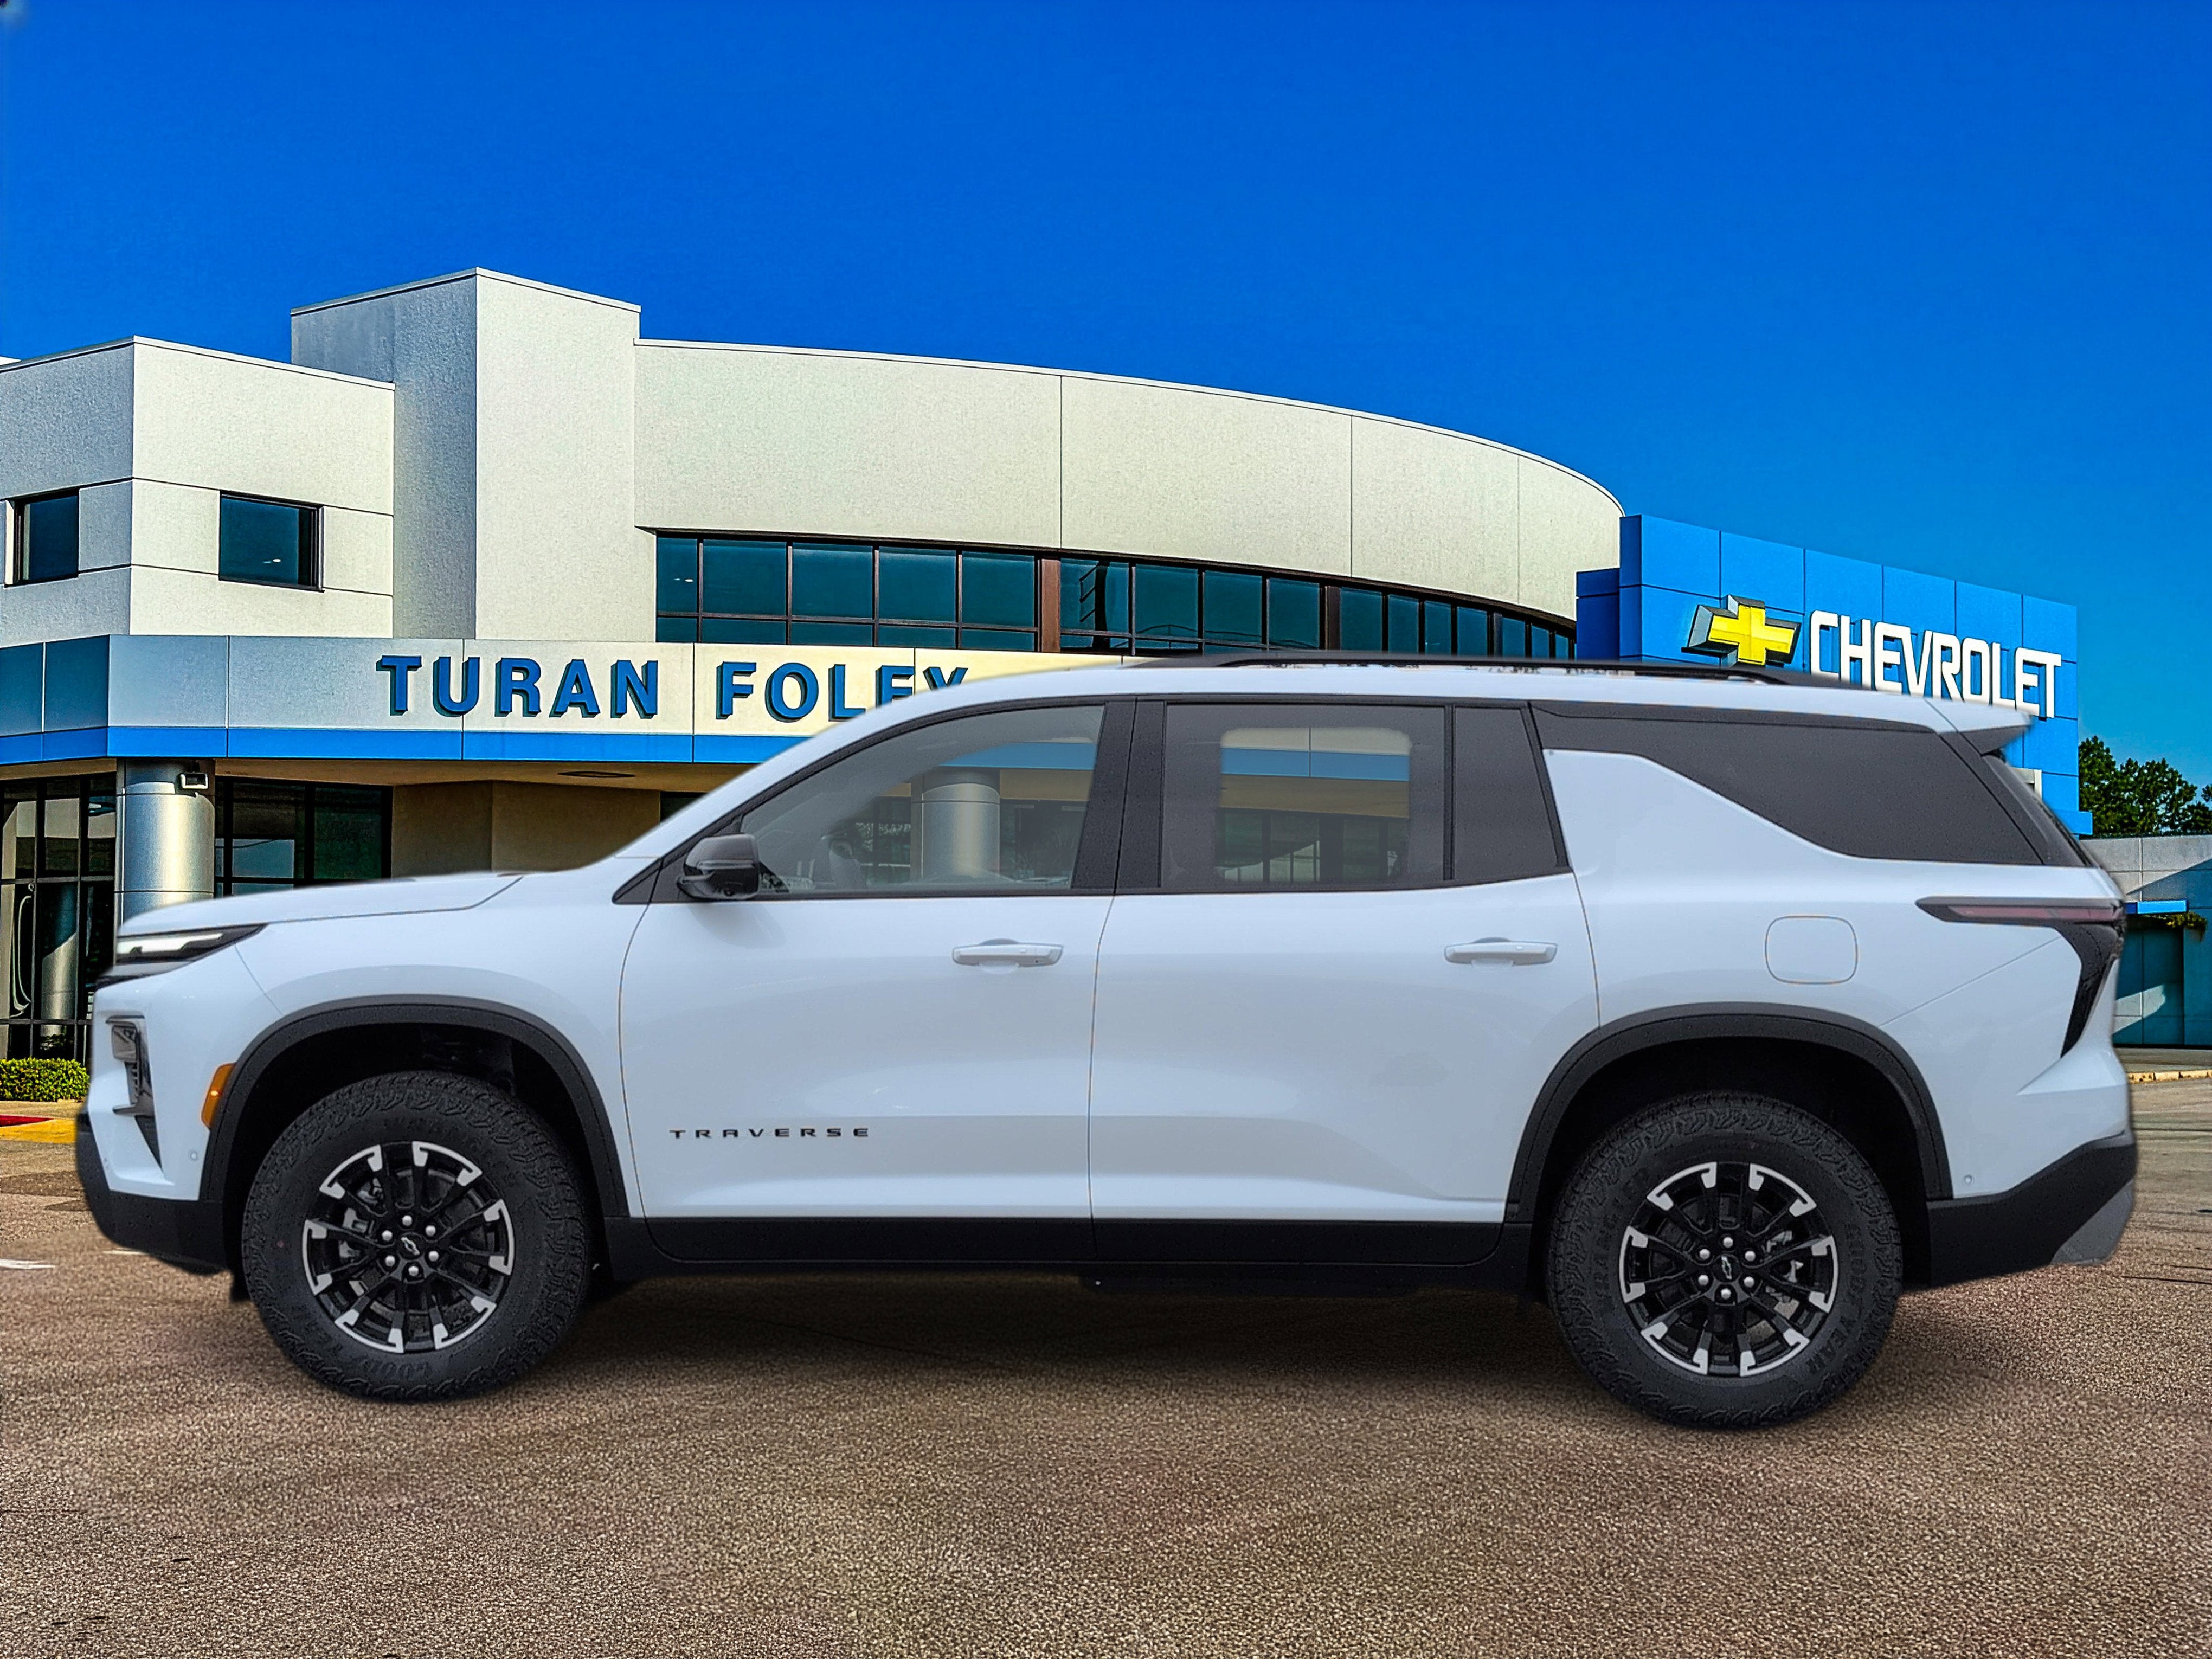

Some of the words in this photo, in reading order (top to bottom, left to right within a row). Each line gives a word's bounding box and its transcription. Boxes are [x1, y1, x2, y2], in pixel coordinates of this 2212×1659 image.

[376, 655, 658, 719] TURAN
[1810, 610, 2062, 718] CHEVROLET
[670, 1128, 869, 1139] TRAVERSE
